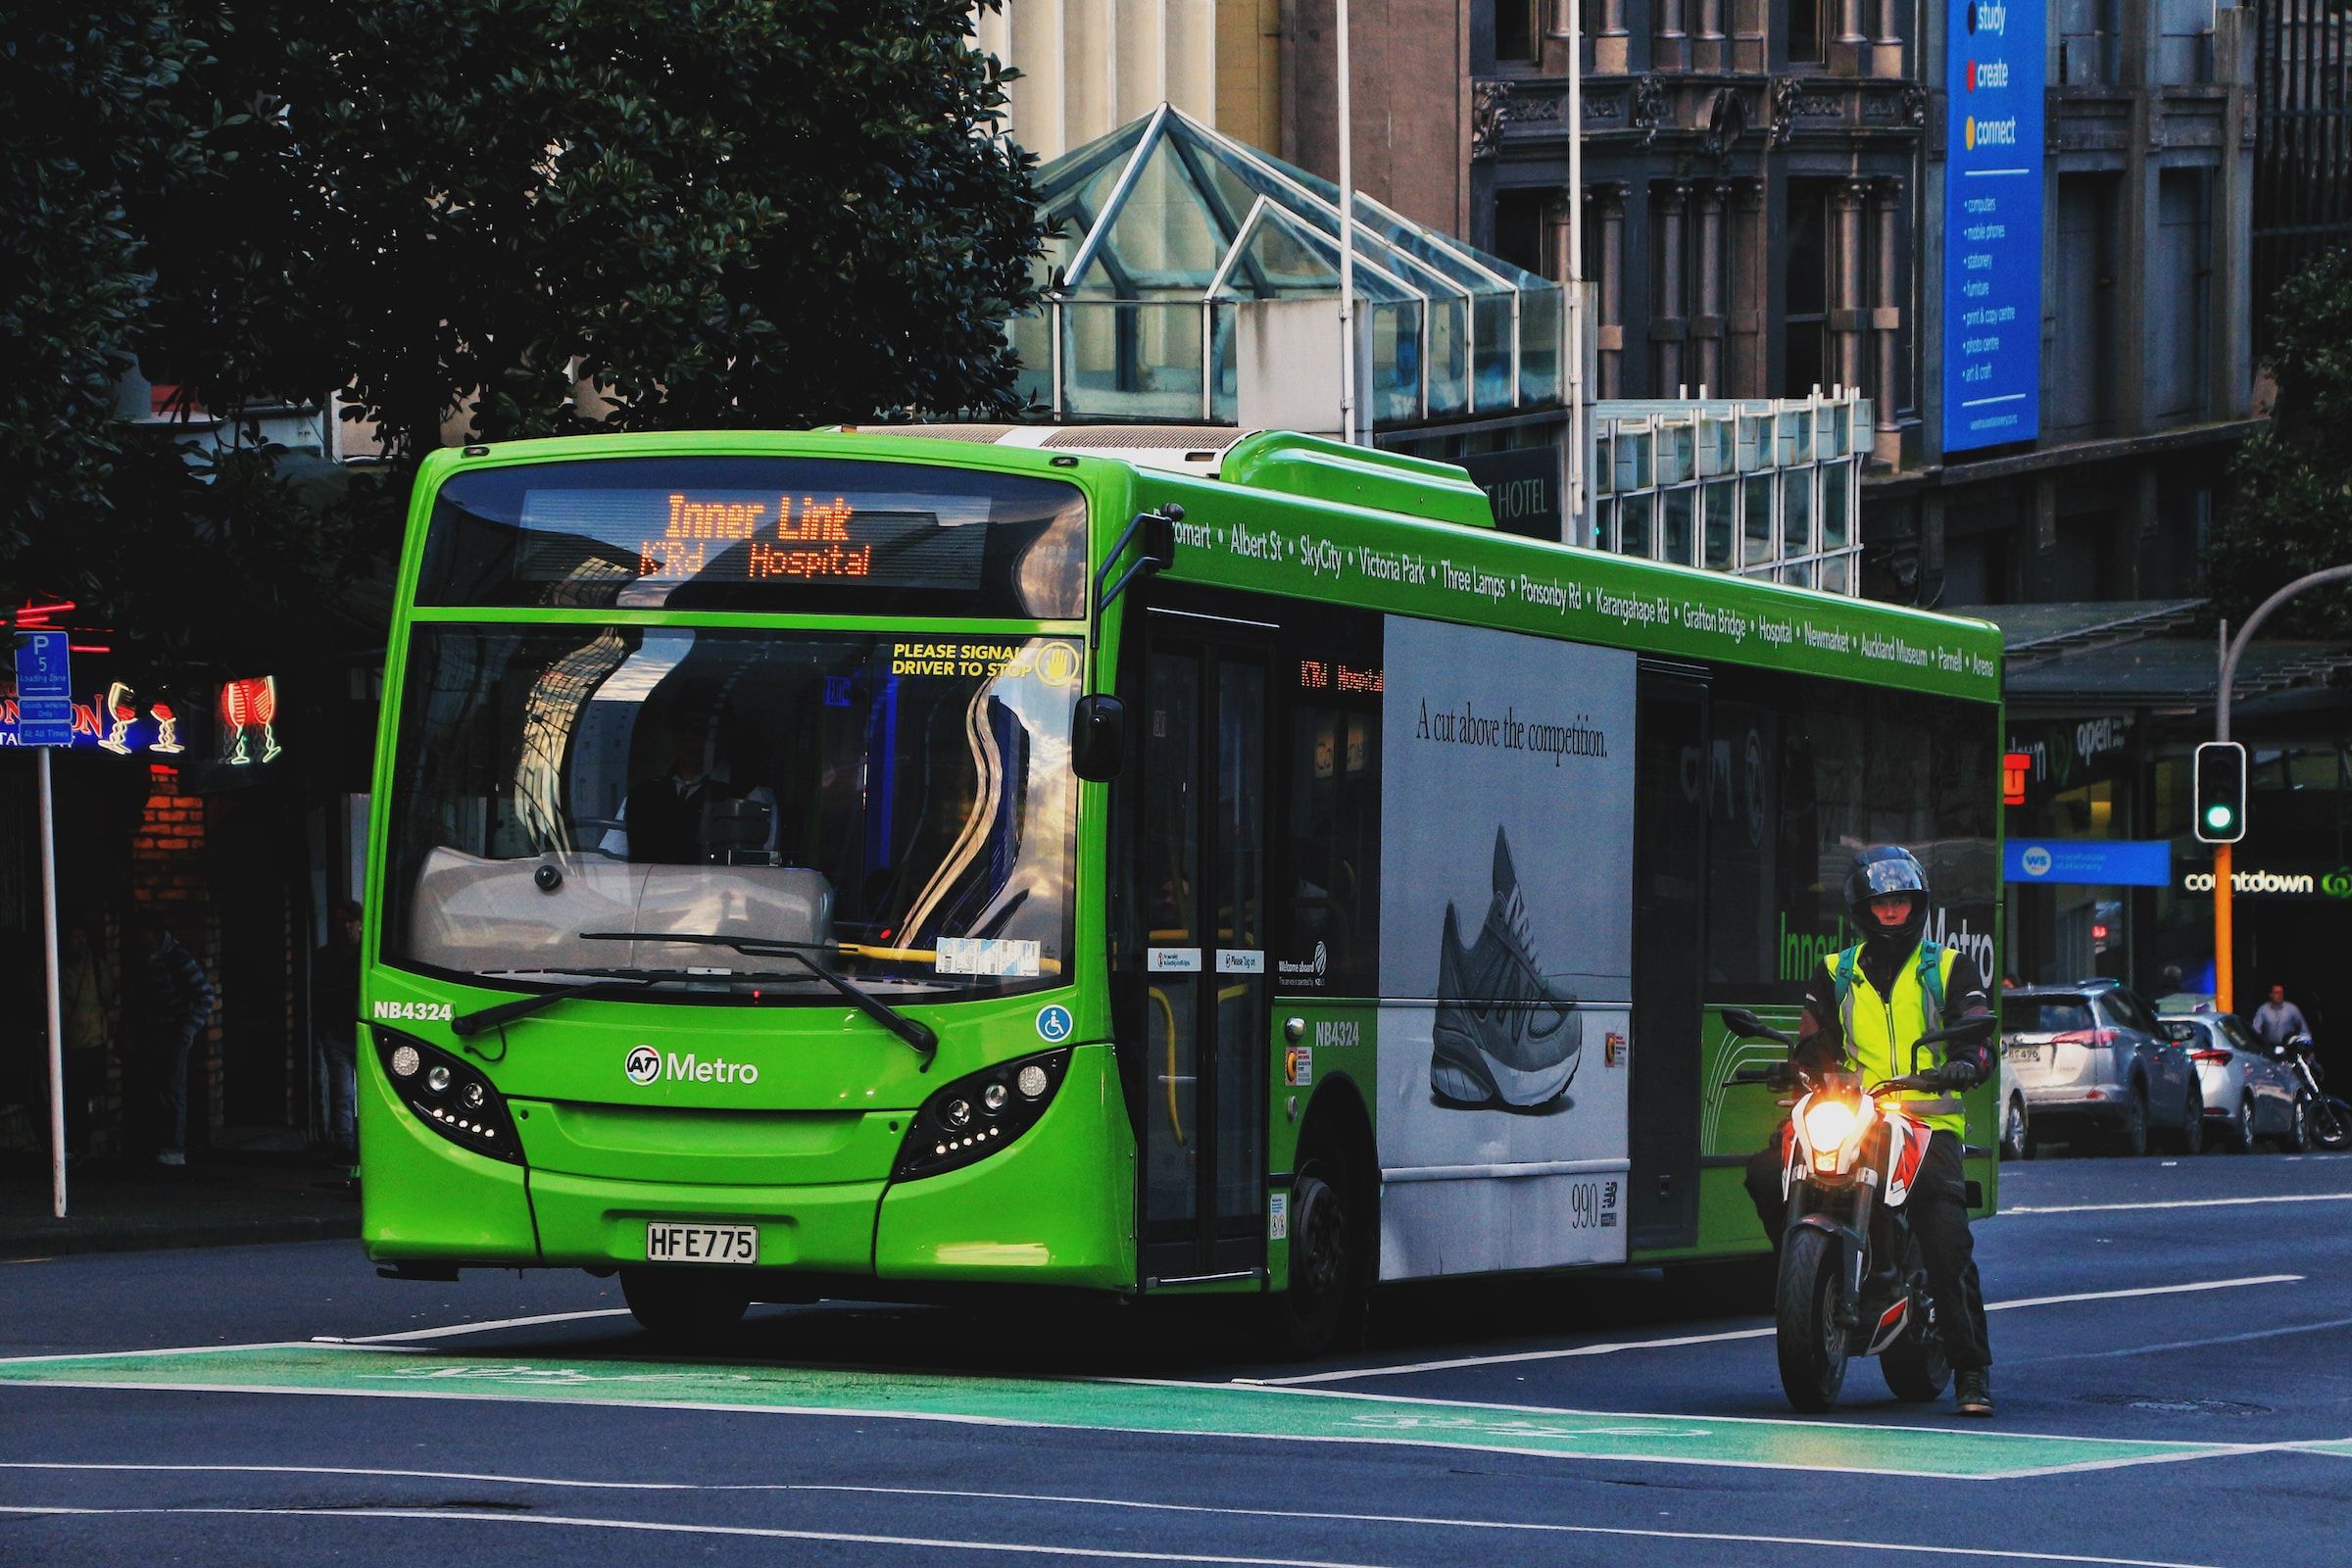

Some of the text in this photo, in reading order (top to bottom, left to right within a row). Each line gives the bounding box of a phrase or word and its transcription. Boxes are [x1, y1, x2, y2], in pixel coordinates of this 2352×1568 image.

[1978, 1, 2006, 36] study
[1977, 58, 2008, 87] create
[1977, 116, 2016, 145] connect
[1968, 196, 1996, 214] computers
[1967, 221, 2005, 241] mobile phones
[1966, 336, 1983, 356] photo
[1497, 478, 1548, 518] HOTEL
[664, 494, 854, 540] Inner Link
[748, 542, 870, 579] Hospital
[1171, 521, 1994, 676] omart Albert St SkyCity Victoria Park Three Lamps Ponsonby Rd Karangahape Rd Grafton Bridge Hospital Newmarket Auckland Museum Parnell Arena
[33, 635, 49, 655] P
[893, 643, 956, 659] PLEASE
[20, 673, 67, 684] Loading Zone
[38, 657, 47, 672] 5
[892, 661, 1033, 678] DRIVER TO STOP
[1416, 697, 1608, 766] A cut above the competition.
[2077, 716, 2113, 766] open
[2184, 869, 2314, 893] contdown
[373, 1001, 453, 1021] NB4324
[1315, 1021, 1360, 1047] NB4324
[666, 1052, 759, 1085] Metro
[1572, 1183, 1598, 1229] 990
[651, 1228, 753, 1258] HFE775
